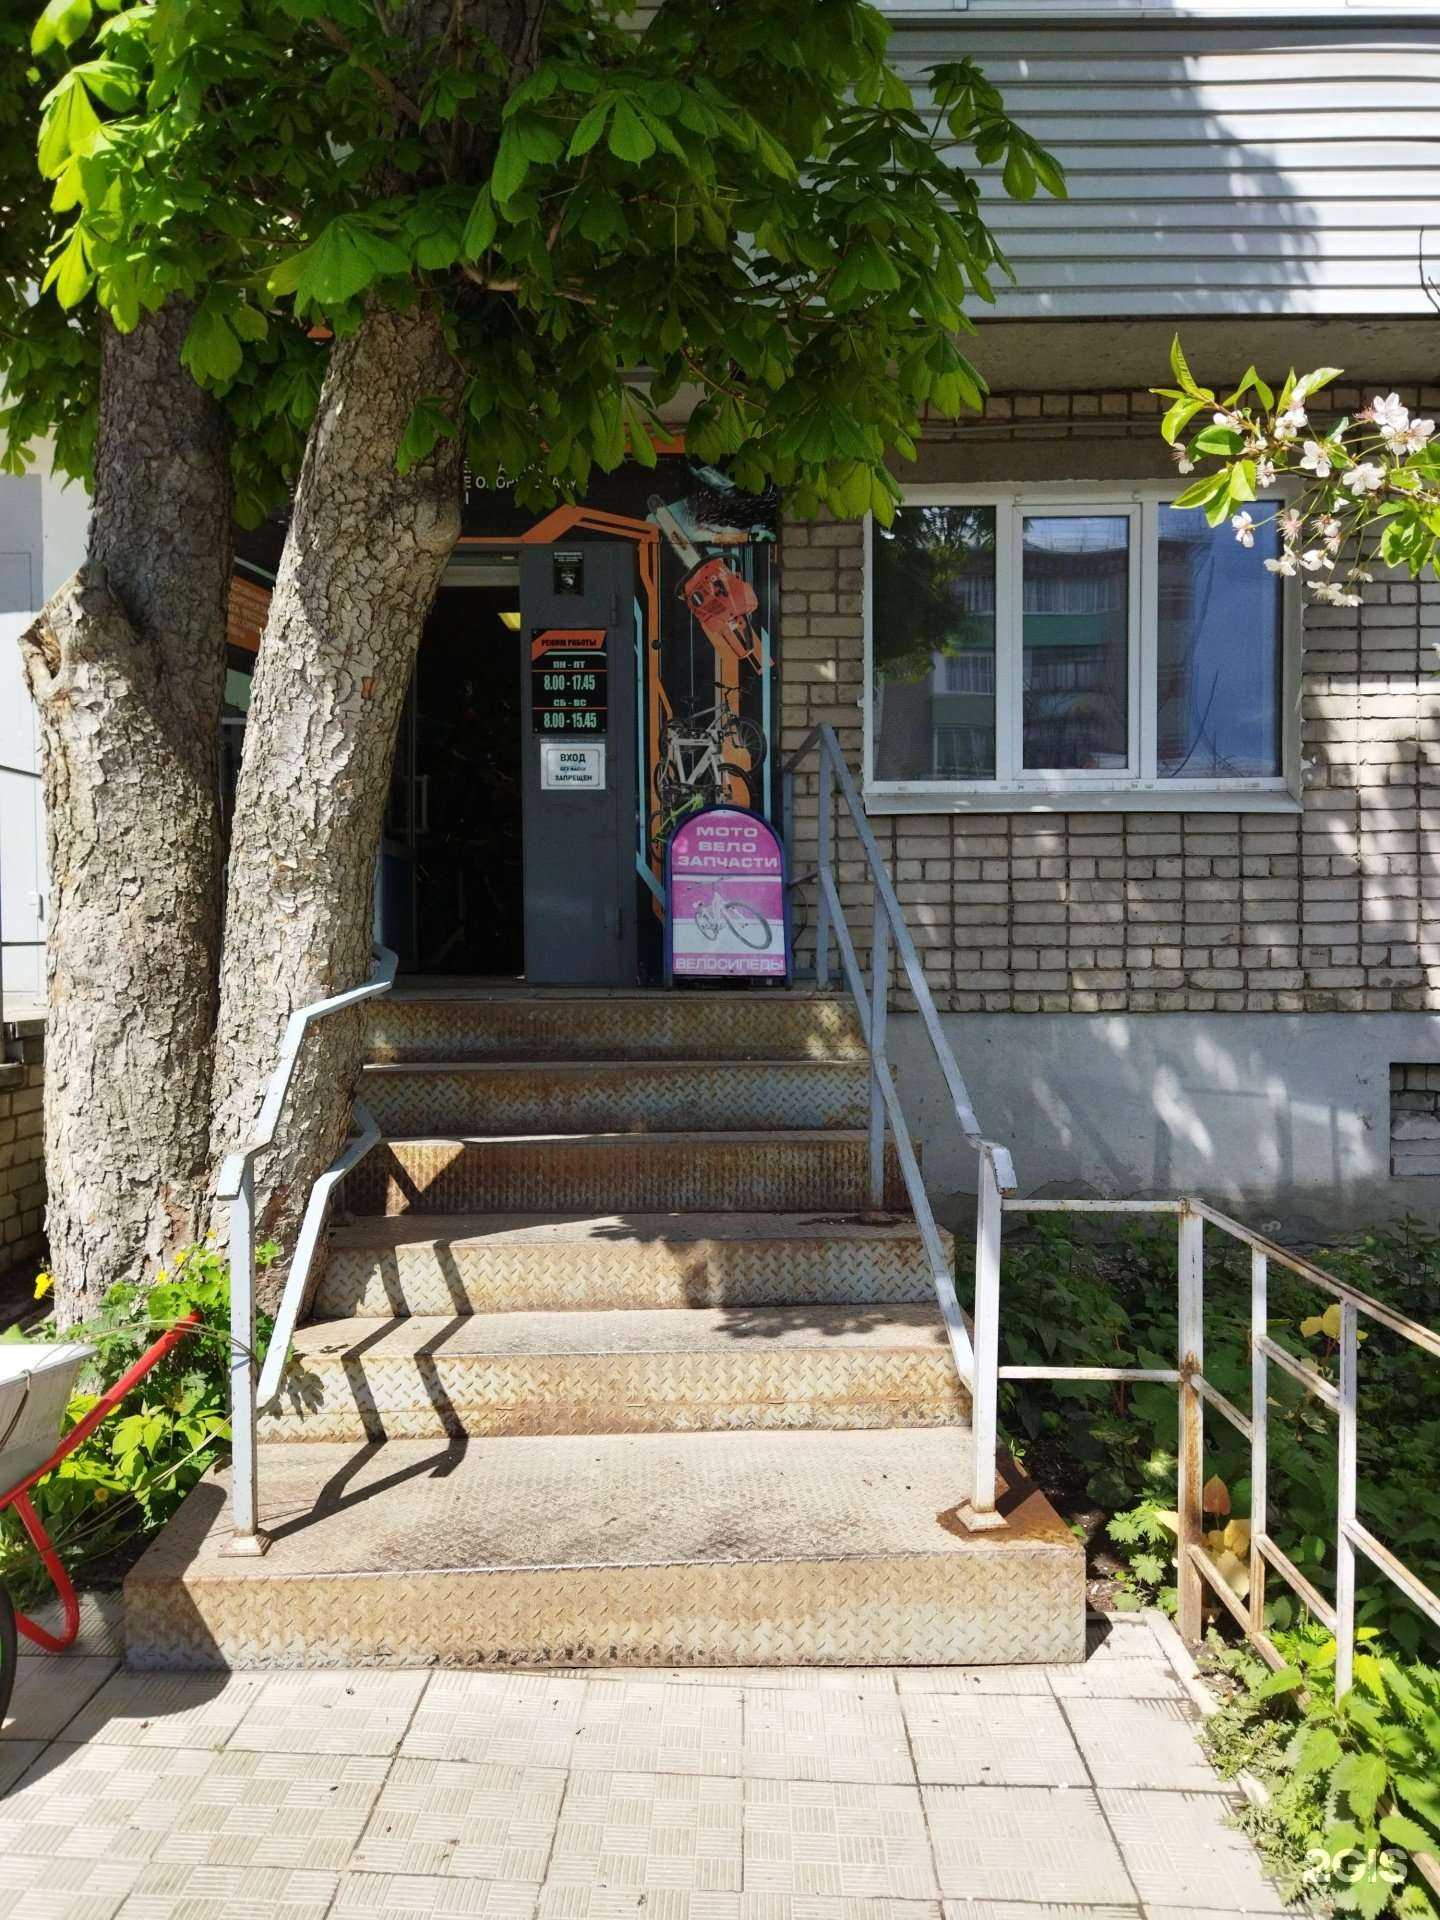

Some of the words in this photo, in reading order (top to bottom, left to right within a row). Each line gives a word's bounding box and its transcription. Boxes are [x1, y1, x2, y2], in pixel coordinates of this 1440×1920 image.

[567, 639, 597, 647] РАБОТЫ
[553, 661, 566, 669] ПН
[573, 661, 586, 669] ПТ
[544, 674, 565, 690] 8.00
[572, 674, 596, 690] 17.45
[553, 699, 566, 707] СБ
[573, 699, 587, 707] ВС
[544, 712, 565, 728] 8.00
[572, 712, 597, 728] 15.45
[560, 753, 586, 763] ВХОД
[696, 826, 758, 838] МОТО
[698, 842, 757, 853] ВЕЛО
[678, 856, 778, 868] ЗАПЧАСТИ
[675, 957, 784, 970] ВЕЛОСИПЕДЫ
